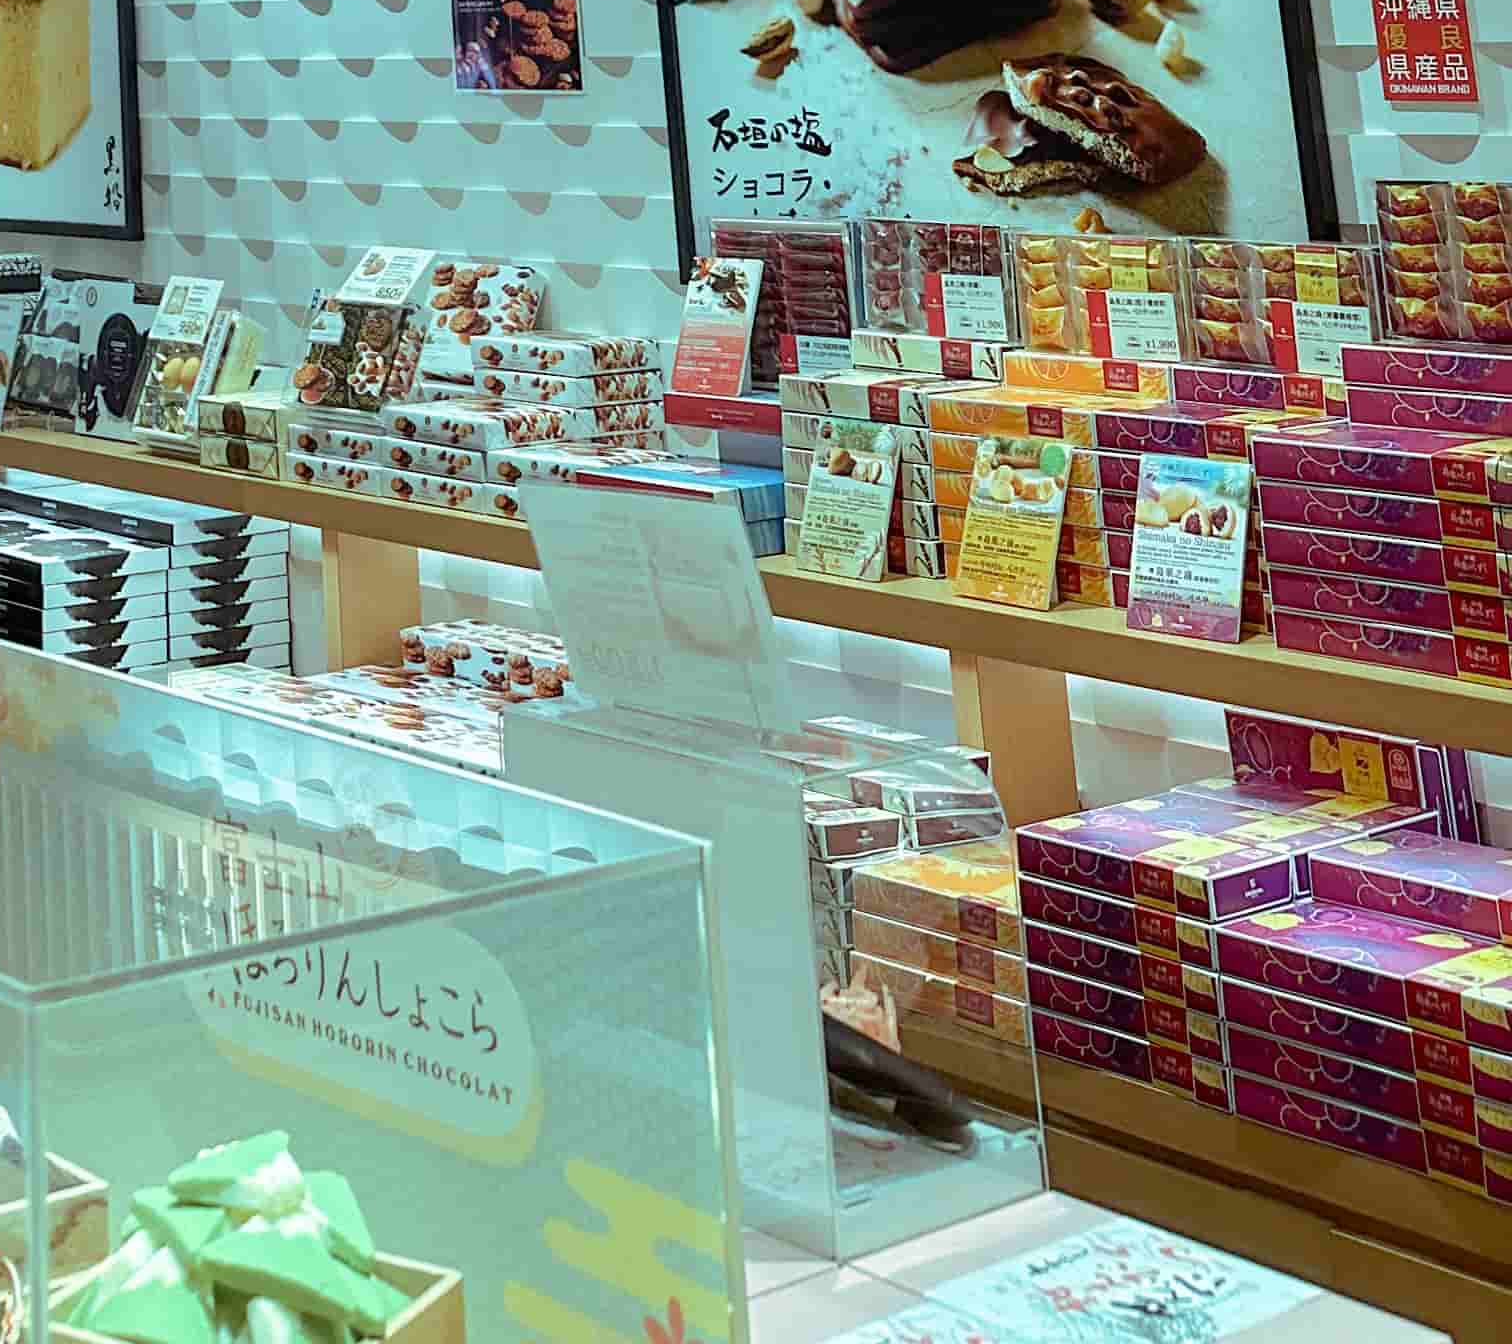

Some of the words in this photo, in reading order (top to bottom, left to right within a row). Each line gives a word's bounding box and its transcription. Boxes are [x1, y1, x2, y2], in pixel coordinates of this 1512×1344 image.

[1386, 53, 1469, 81] 県産品
[1438, 83, 1470, 95] BRAND
[707, 105, 833, 157] 石垣の塩
[232, 989, 308, 1032] FUJISAN
[403, 1051, 514, 1106] CHOCOLAT
